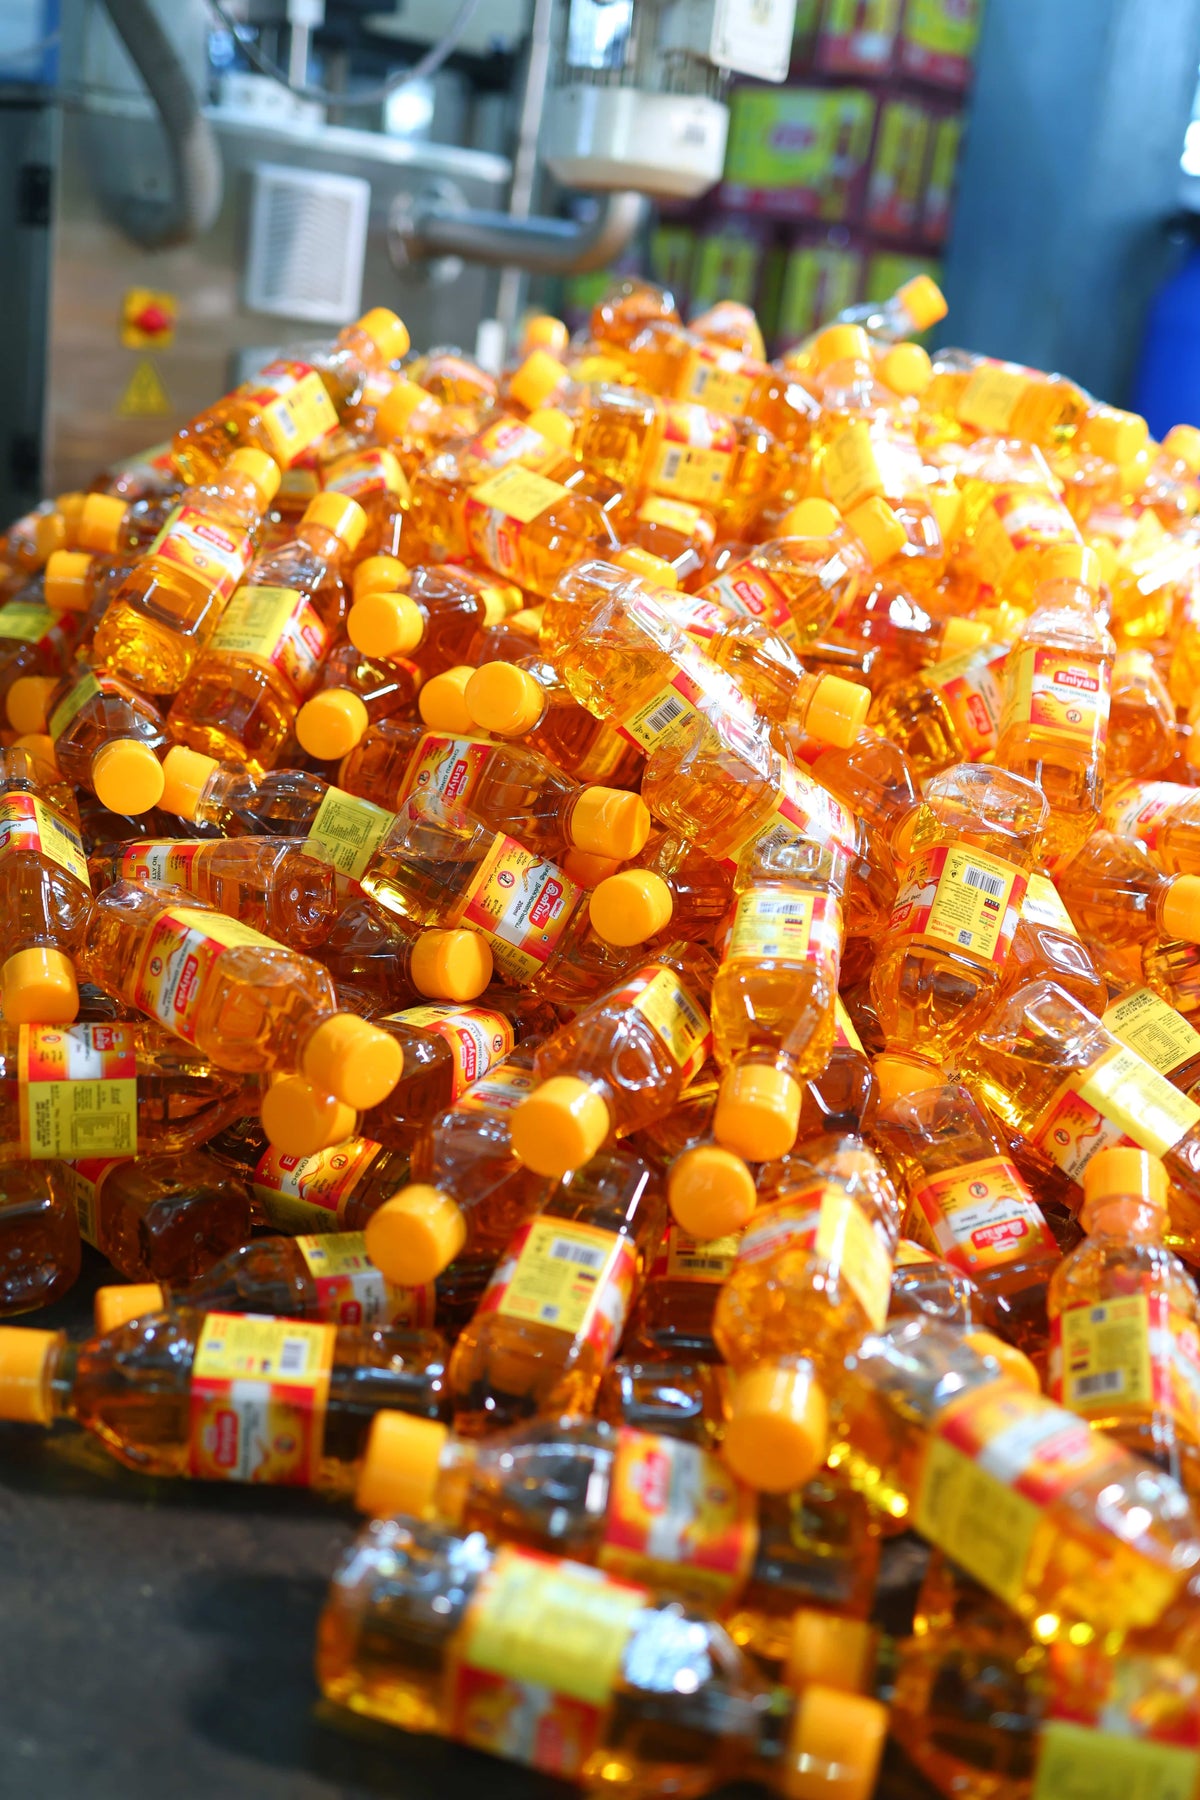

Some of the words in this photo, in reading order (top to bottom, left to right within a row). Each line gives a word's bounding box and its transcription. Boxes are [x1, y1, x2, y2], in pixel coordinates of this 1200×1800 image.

[1058, 672, 1096, 689] Eniyaa
[512, 900, 523, 916] 200ml
[531, 882, 561, 922] இனியா
[175, 960, 197, 1009] Eniyaa
[462, 1033, 475, 1077] Eniyaa
[290, 1158, 309, 1186] CHEKKU
